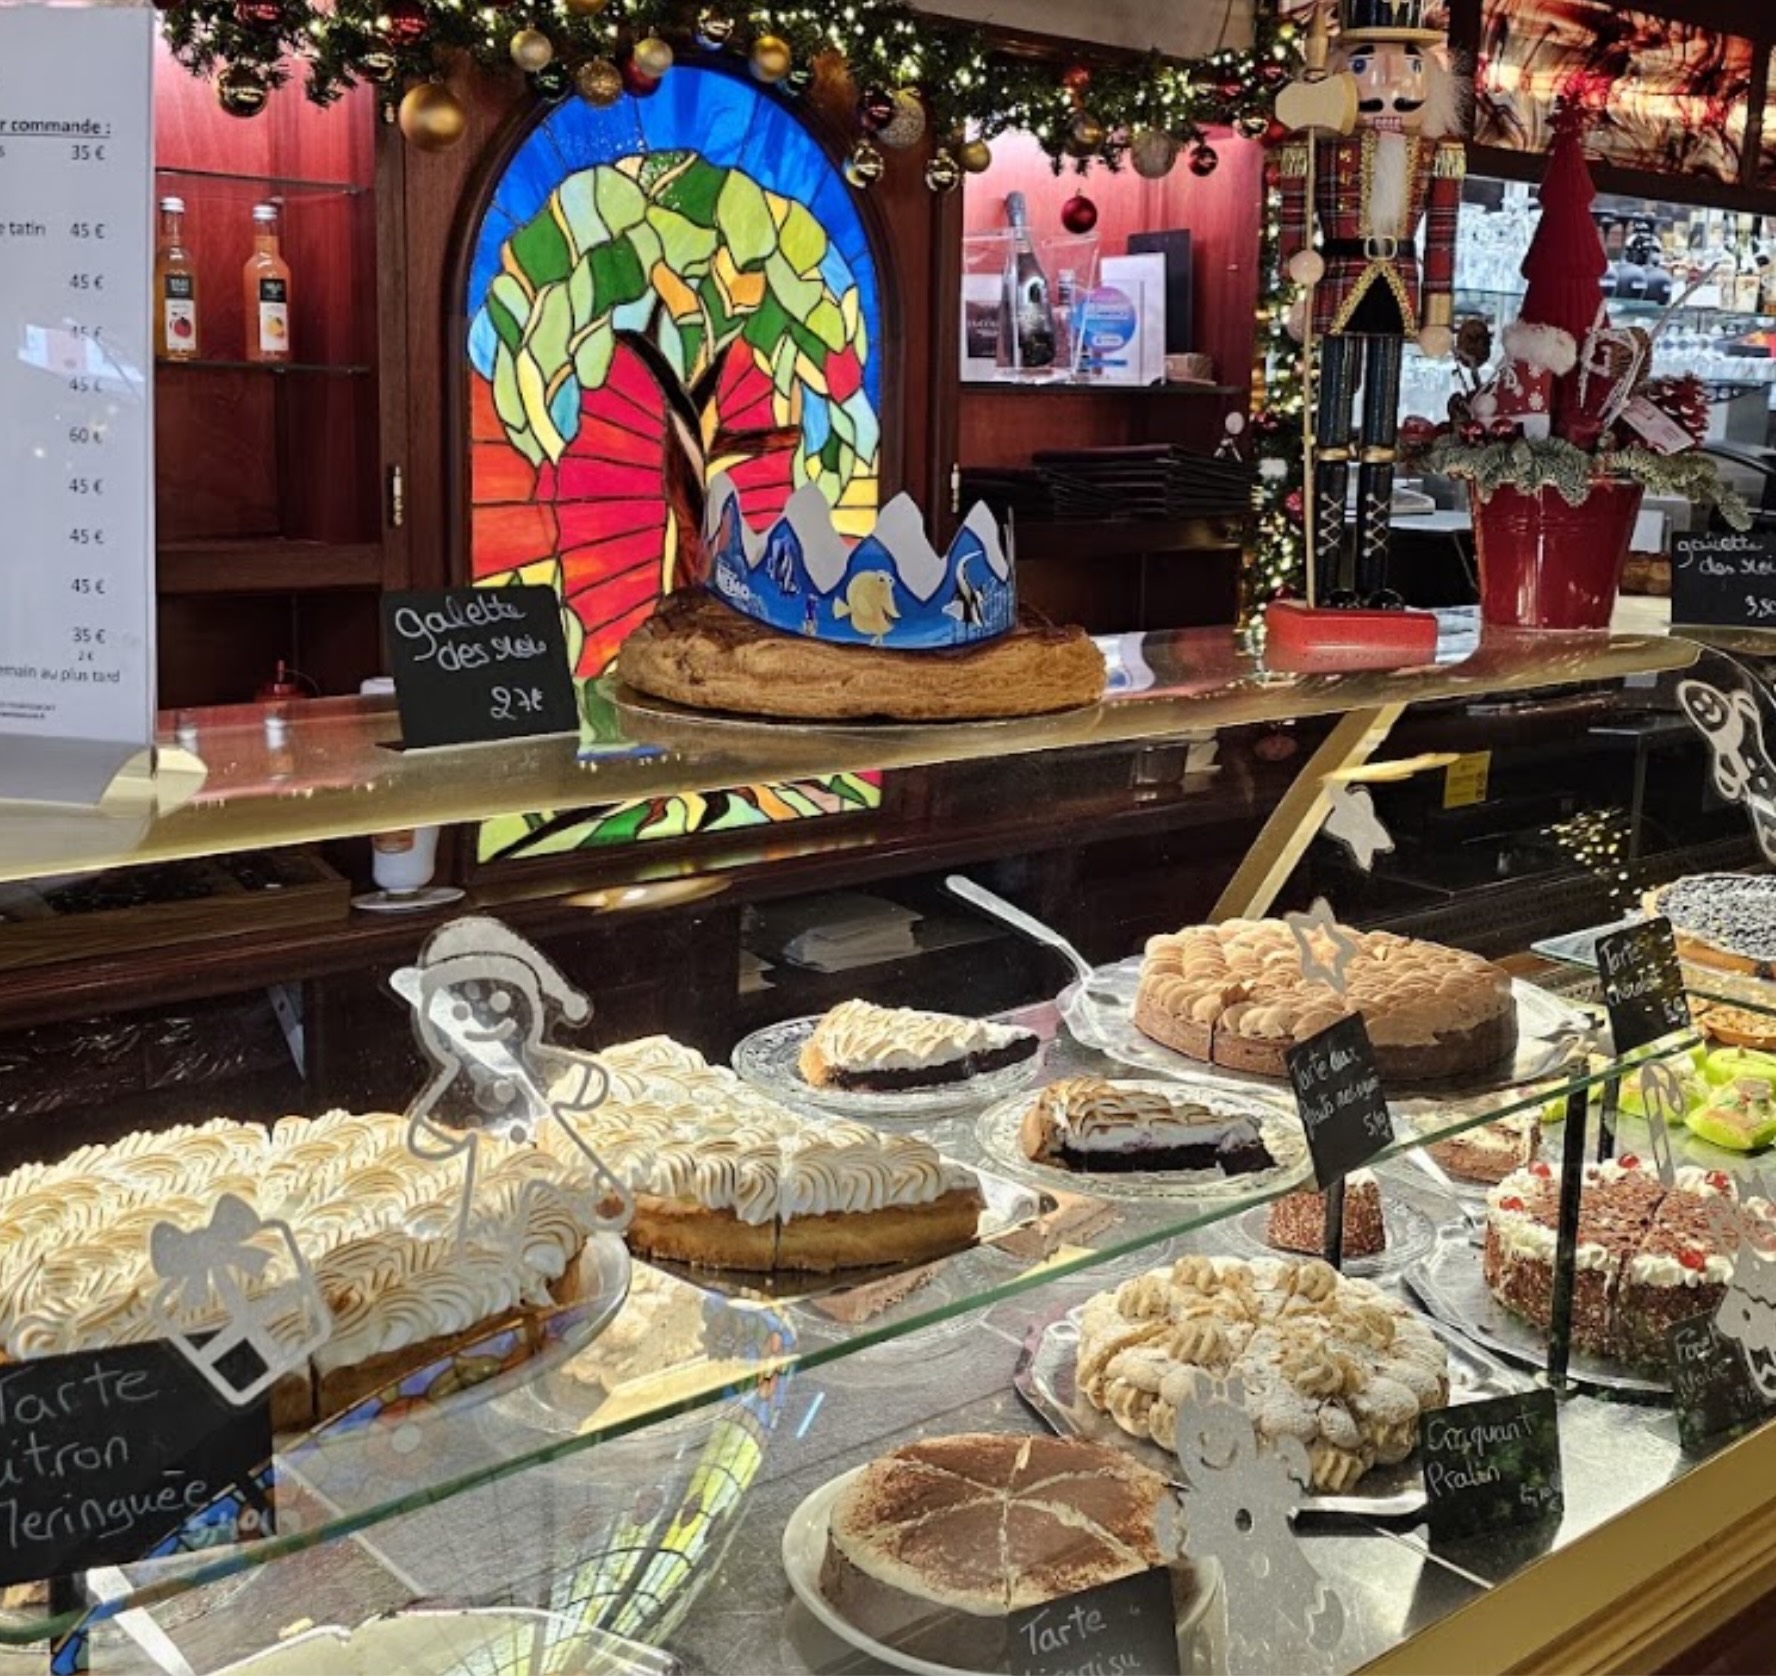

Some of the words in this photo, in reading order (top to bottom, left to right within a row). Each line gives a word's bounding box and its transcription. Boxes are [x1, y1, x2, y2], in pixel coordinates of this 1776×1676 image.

[11, 118, 101, 134] commande
[71, 144, 91, 160] 35
[9, 220, 47, 236] tatin
[70, 222, 89, 239] 45
[69, 274, 89, 290] 45
[69, 377, 89, 392] 45
[69, 426, 89, 443] 60
[69, 478, 89, 494] 45
[69, 528, 89, 544] 45
[71, 578, 90, 594] 45
[72, 626, 91, 642] 35
[60, 667, 89, 683] plus
[0, 1431, 129, 1487] itron
[1020, 1605, 1106, 1655] Tarte
